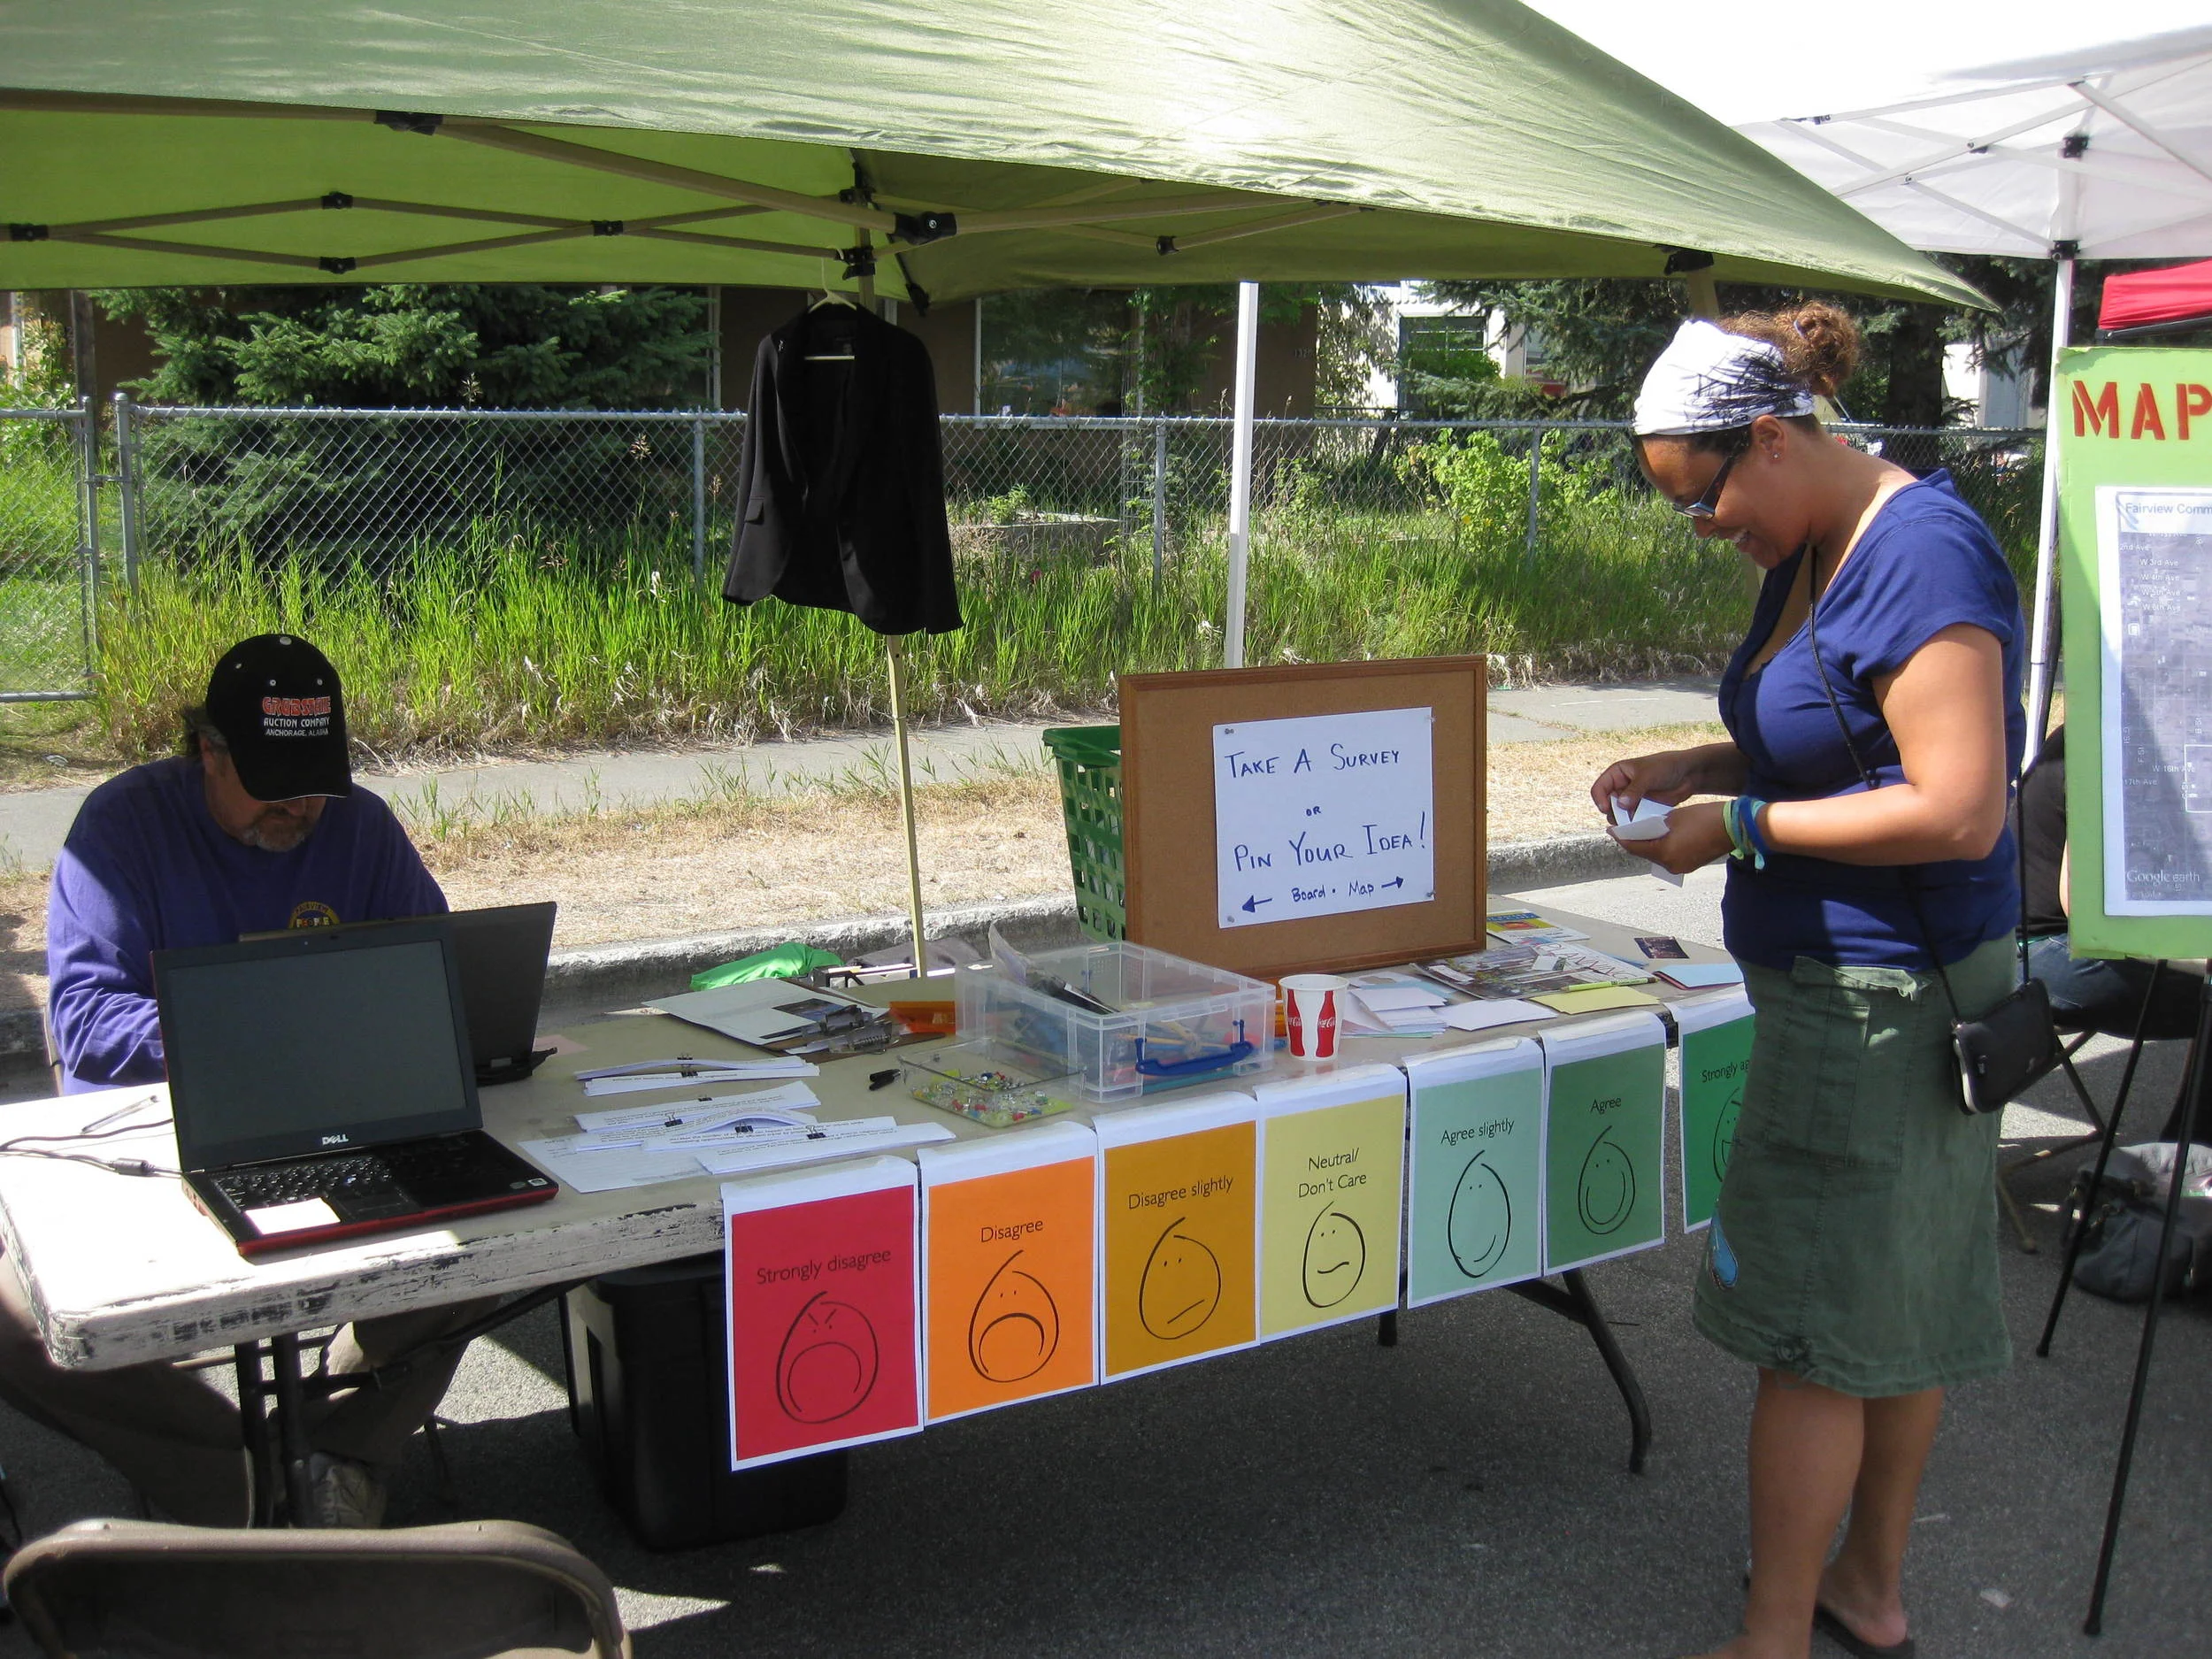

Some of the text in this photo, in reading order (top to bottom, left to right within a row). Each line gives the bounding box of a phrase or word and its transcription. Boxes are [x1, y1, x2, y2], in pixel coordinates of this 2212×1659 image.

[2072, 380, 2212, 440] MAP
[2125, 502, 2173, 514] Fairview
[264, 717, 330, 728] AUCTION COMPANY
[1225, 742, 1400, 779] TAKE A SURVEY
[1306, 805, 1322, 817] OR
[1233, 843, 1272, 872] PIN
[1288, 830, 1354, 866] YOUR
[2126, 869, 2200, 886] Google earth
[1291, 879, 1375, 902] Board Map
[1701, 1061, 1738, 1083] Strongly
[1591, 1095, 1623, 1115] Agree
[321, 1133, 349, 1146] DELL
[1440, 1118, 1516, 1145] Agree slightly
[1308, 1148, 1360, 1171] Neutral/
[1128, 1176, 1234, 1210] Disagree slightly
[1298, 1171, 1367, 1198] Don't Care
[981, 1218, 1044, 1243] Disagree
[757, 1248, 892, 1285] Strongly disagree
